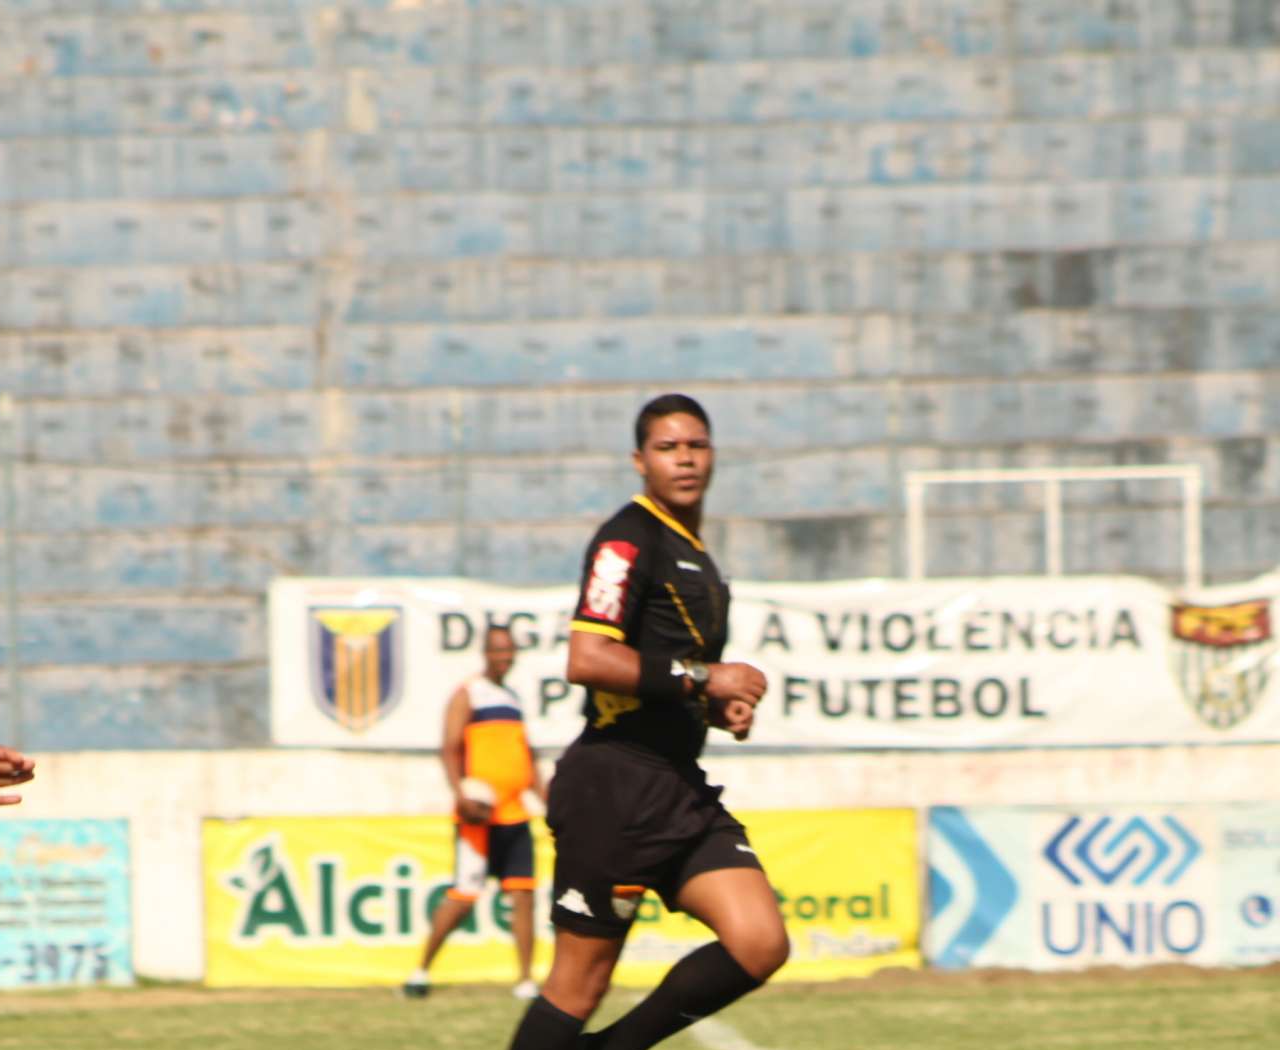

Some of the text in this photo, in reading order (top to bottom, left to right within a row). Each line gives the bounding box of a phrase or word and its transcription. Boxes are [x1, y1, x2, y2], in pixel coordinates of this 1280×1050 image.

[782, 677, 1048, 720] FUTEBOL
[240, 861, 558, 937] Alcie
[1042, 901, 1205, 956] UNIO
